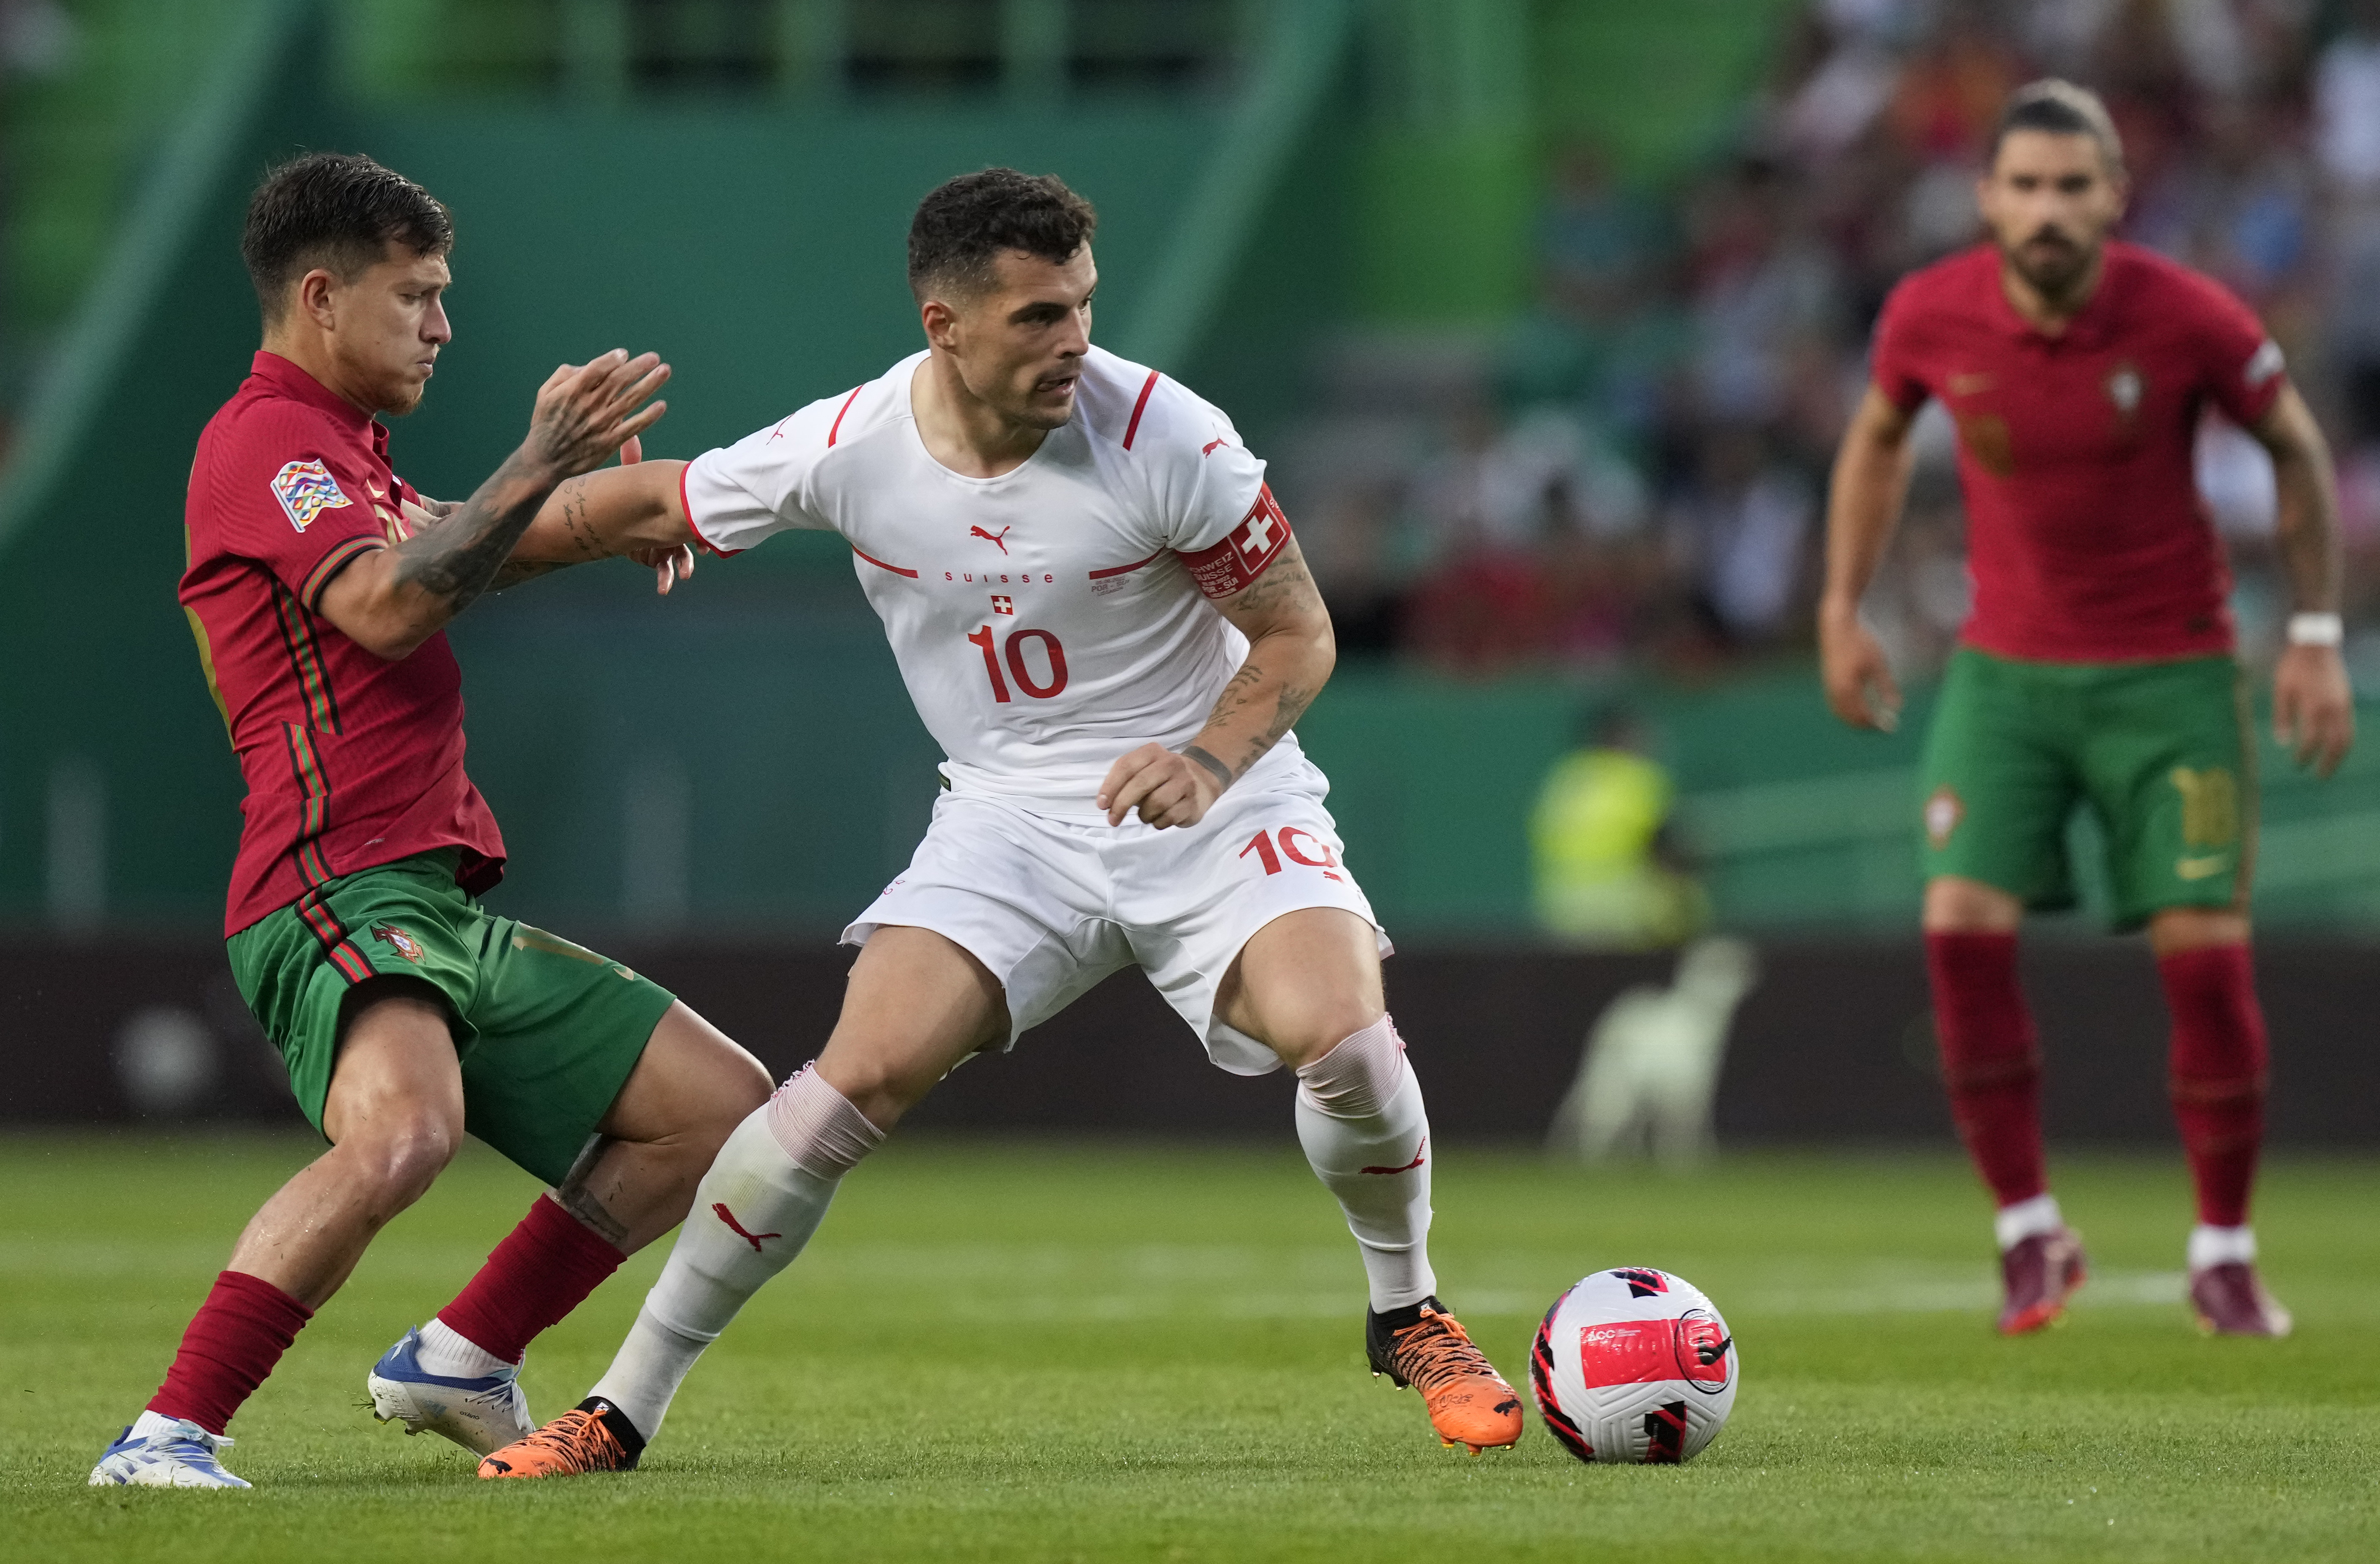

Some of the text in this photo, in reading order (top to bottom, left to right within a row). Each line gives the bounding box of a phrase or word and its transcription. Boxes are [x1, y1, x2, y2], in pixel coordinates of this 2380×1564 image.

[1189, 551, 1234, 573] CHWEIZ
[945, 572, 1053, 583] suisse
[1223, 577, 1239, 588] SUI
[968, 625, 1068, 703] 10
[1239, 826, 1338, 876] 10
